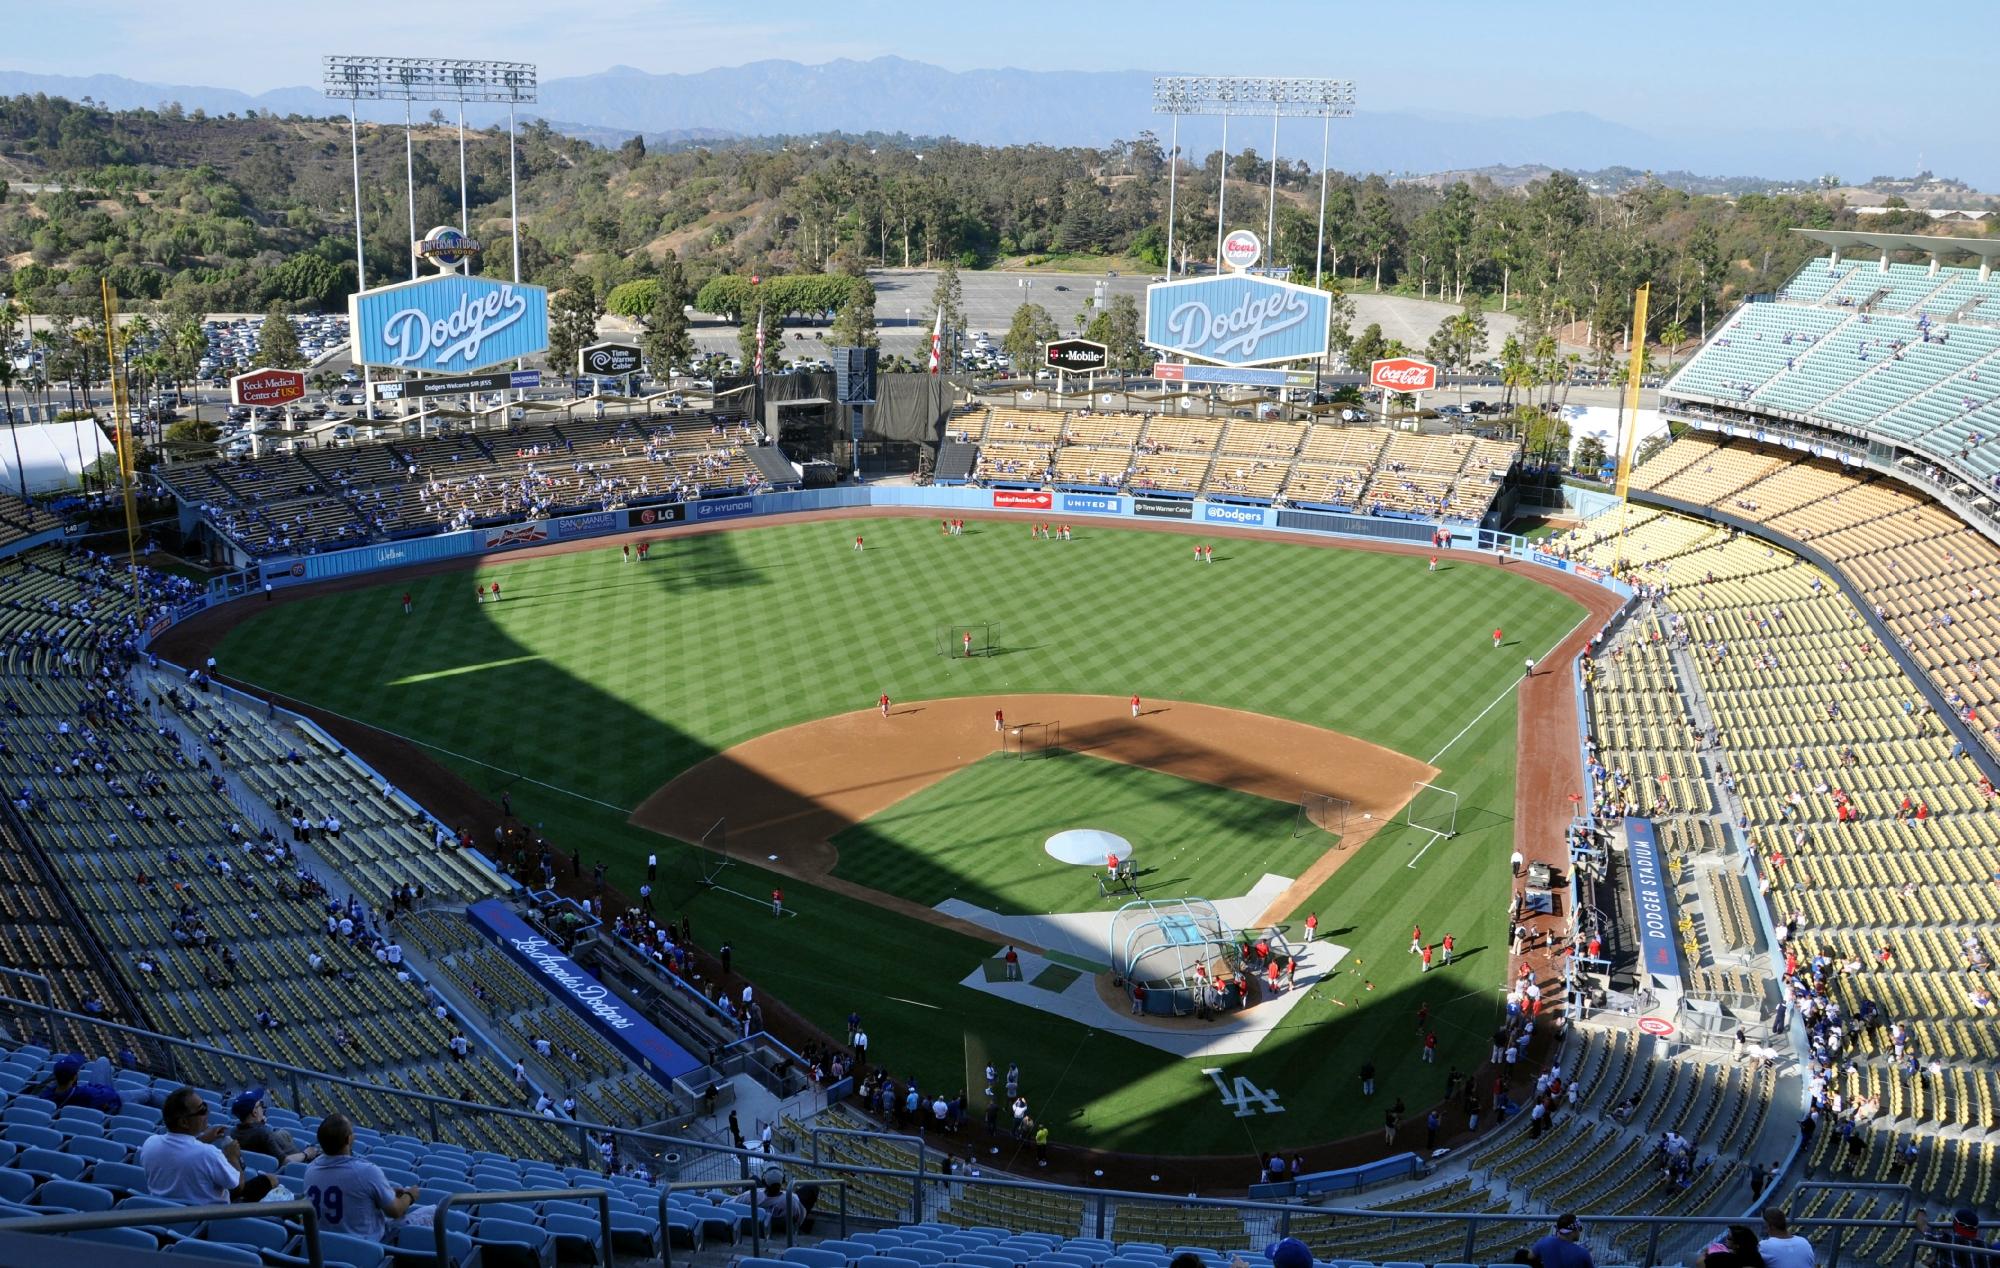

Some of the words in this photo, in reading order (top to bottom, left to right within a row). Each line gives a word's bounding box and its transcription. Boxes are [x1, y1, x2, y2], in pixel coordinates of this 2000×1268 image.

[421, 239, 455, 252] UNIVERSAL
[456, 238, 480, 251] STUDIOS
[1228, 240, 1255, 252] Coors
[242, 381, 263, 391] Keck
[265, 376, 295, 388] Medical
[377, 383, 403, 393] MUSCLE
[243, 391, 270, 401] Center
[271, 389, 280, 398] of
[281, 386, 300, 397] USC
[382, 391, 398, 399] MILK
[714, 501, 752, 512] HYUNDAI
[1068, 500, 1106, 508] UNITED
[1155, 505, 1175, 513] Warner
[560, 519, 576, 529] SAN
[582, 513, 615, 523] MANUEL
[658, 509, 674, 520] LG
[1208, 506, 1261, 522] @Dodgers
[1633, 840, 1657, 886] STADIUM
[1642, 890, 1667, 939] DODGER
[511, 936, 549, 954] Los
[530, 951, 585, 989] Angeles
[572, 985, 635, 1029] Dodgers
[1201, 1067, 1286, 1118] LA
